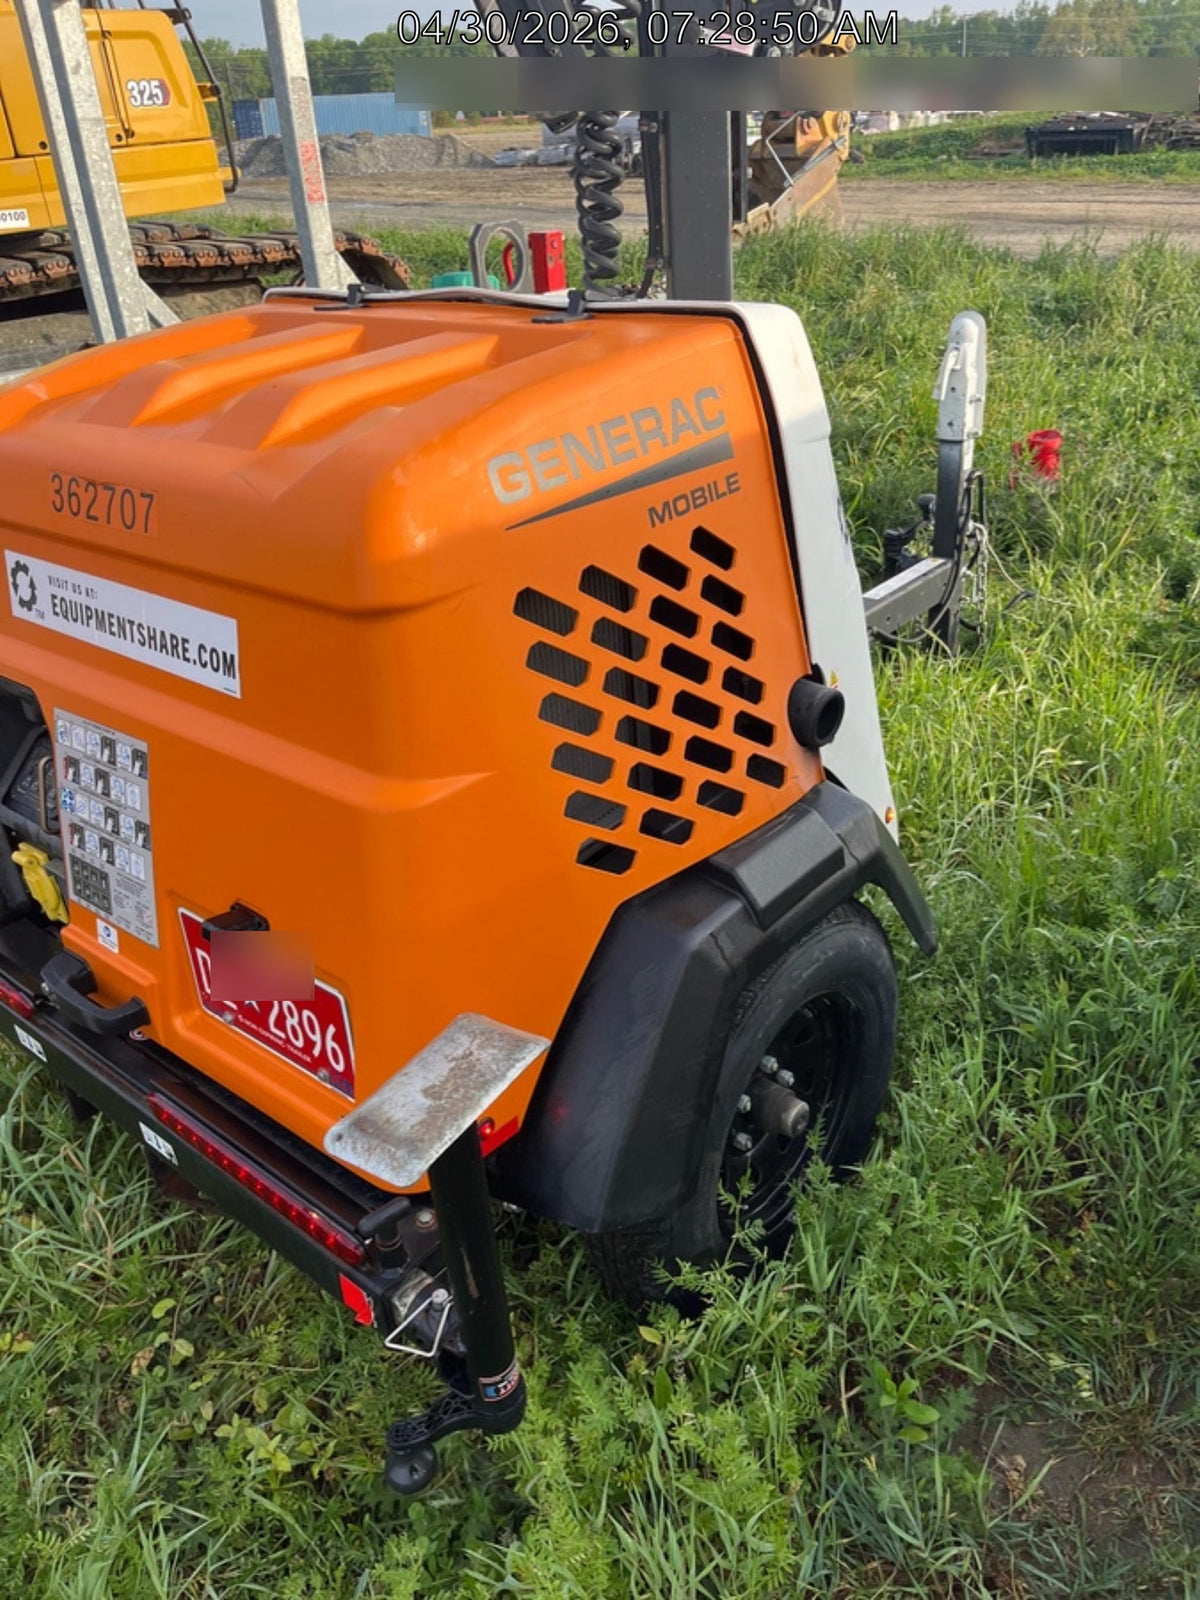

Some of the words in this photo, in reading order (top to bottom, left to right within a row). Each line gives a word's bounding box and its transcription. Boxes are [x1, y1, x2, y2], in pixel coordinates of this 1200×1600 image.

[126, 79, 163, 107] 325
[0, 211, 26, 223] 0100
[487, 386, 725, 504] GENERAC
[51, 473, 155, 534] 362707
[648, 472, 741, 528] MOBILE
[50, 593, 237, 680] EQUIPMENTSHARE.COM
